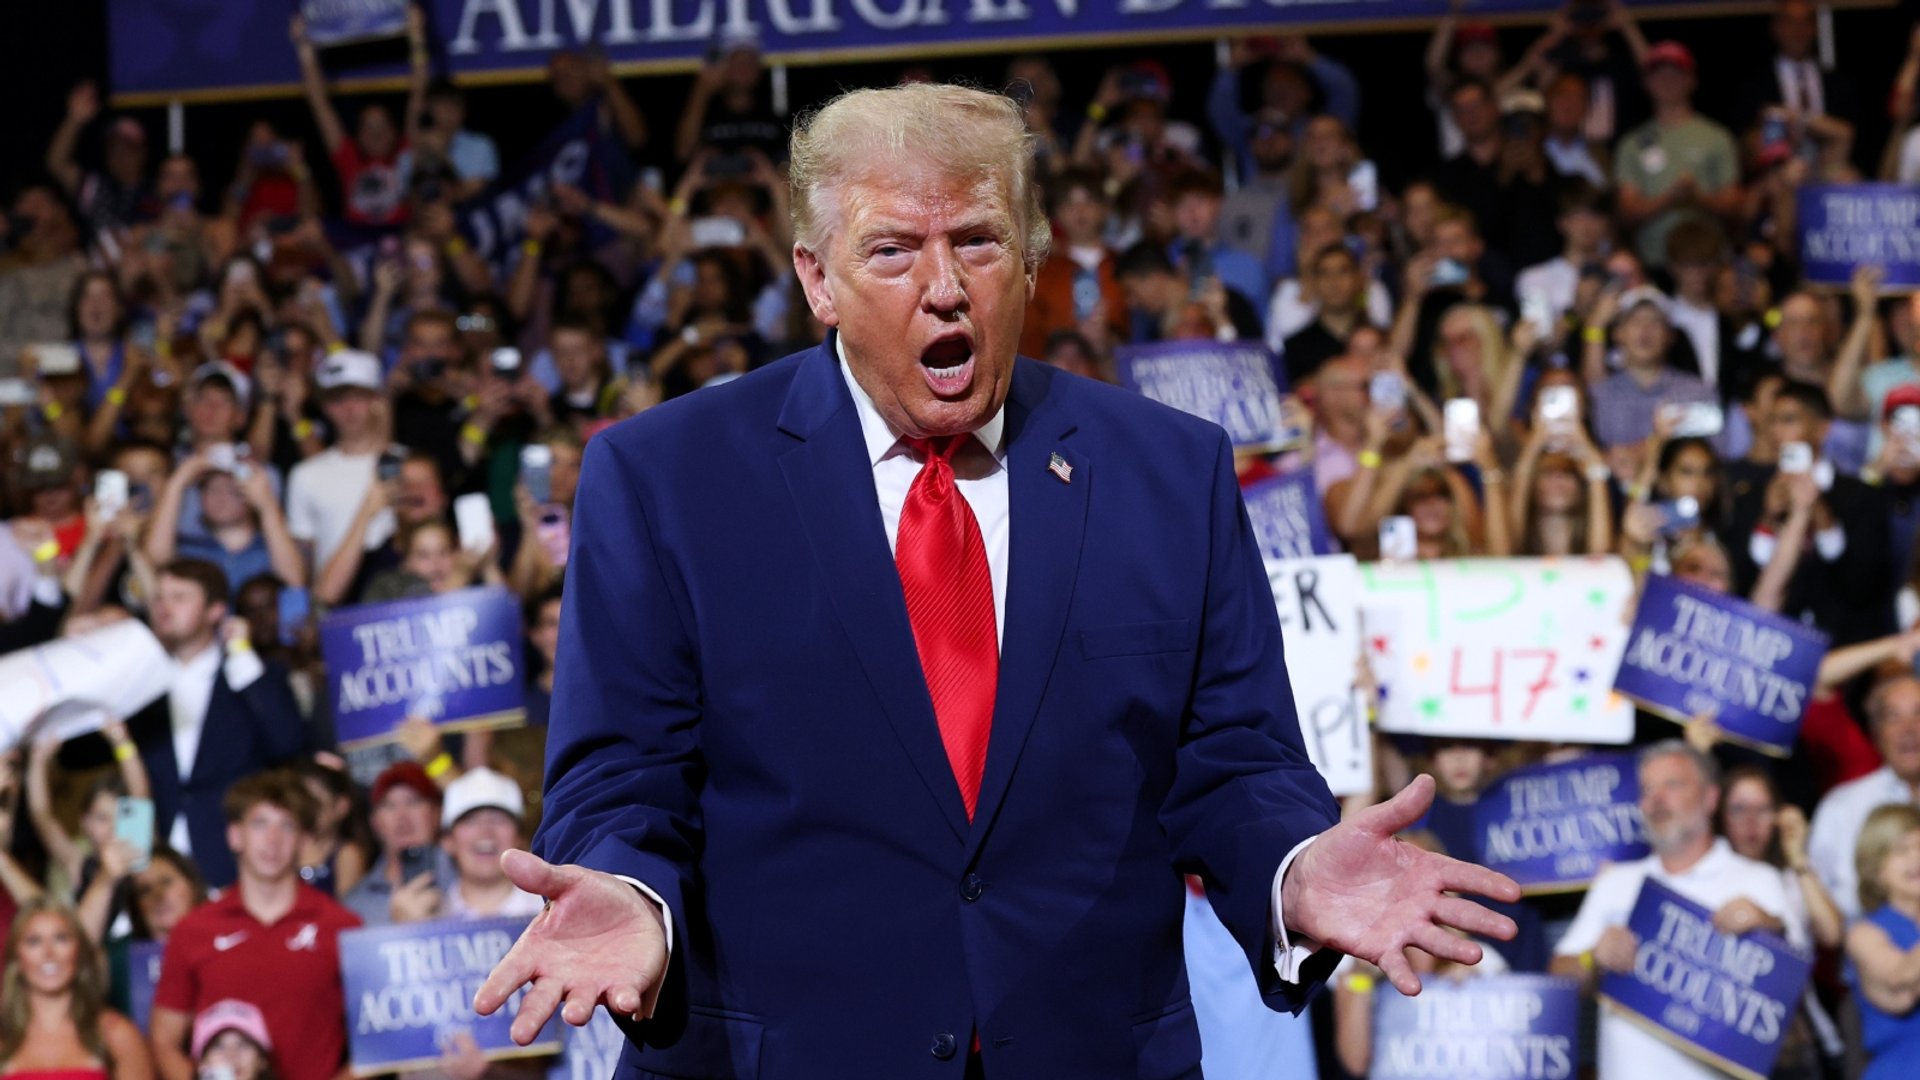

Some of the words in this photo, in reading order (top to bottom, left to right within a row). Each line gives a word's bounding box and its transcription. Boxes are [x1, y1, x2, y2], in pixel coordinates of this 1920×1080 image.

[449, 0, 1078, 53] AMER
[1803, 229, 1920, 262] ACCOUN
[353, 606, 477, 664] TRUMP
[1672, 594, 1793, 670] TRUMP
[338, 640, 514, 714] ACCOUNTS
[1450, 647, 1557, 726] 47
[1627, 628, 1806, 723] ACCOUNTS
[1504, 764, 1620, 818] TRUMP
[379, 930, 513, 983] TRUMP
[1660, 902, 1775, 988] TRUMP
[358, 976, 534, 1034] ACCOU
[1412, 990, 1543, 1034] TRUMP
[1634, 940, 1786, 1044] CCOUNTS
[1382, 1034, 1572, 1080] ACCOUNTS
